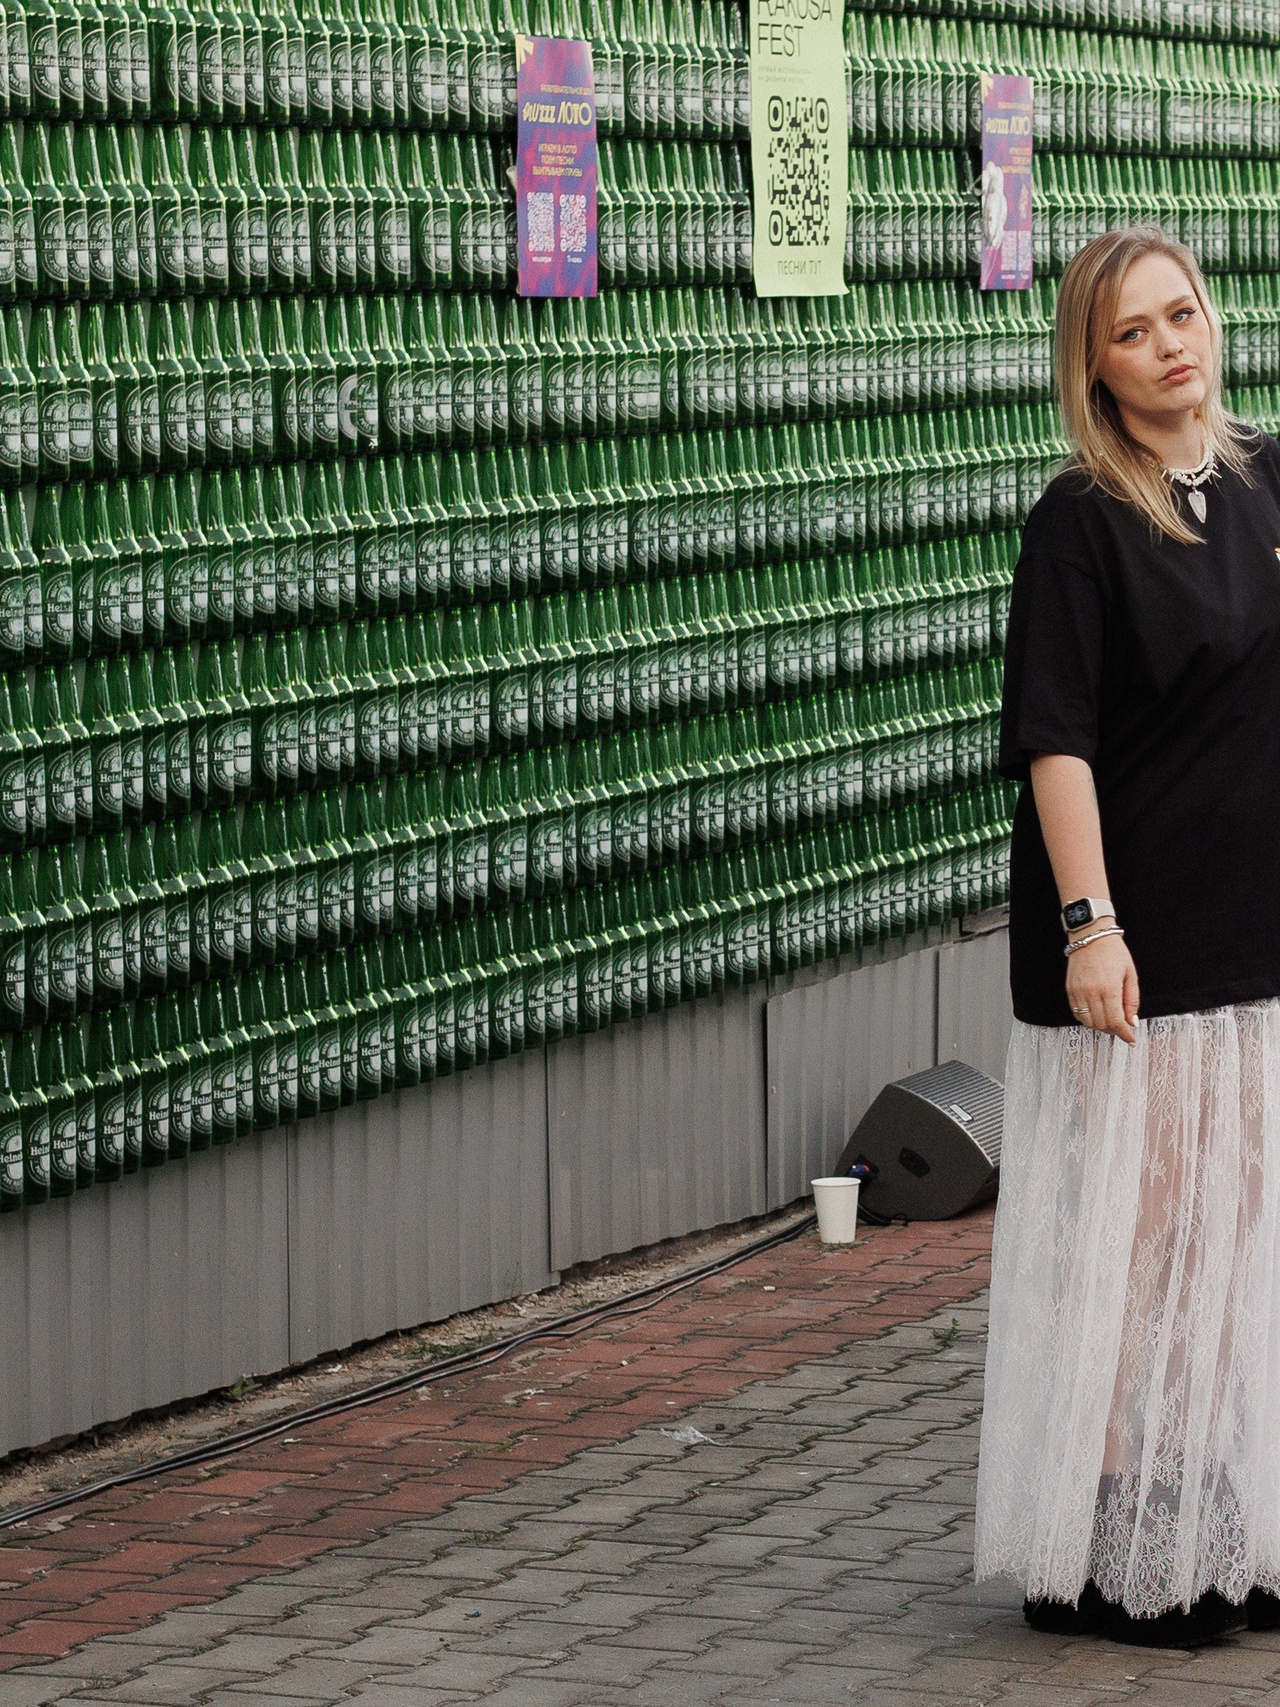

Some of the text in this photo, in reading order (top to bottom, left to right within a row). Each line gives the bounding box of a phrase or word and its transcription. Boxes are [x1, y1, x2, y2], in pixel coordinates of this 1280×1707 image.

[758, 23, 804, 57] FEST
[557, 101, 592, 126] ЛОТО
[777, 260, 822, 275] ПЕСНИ ТУТ
